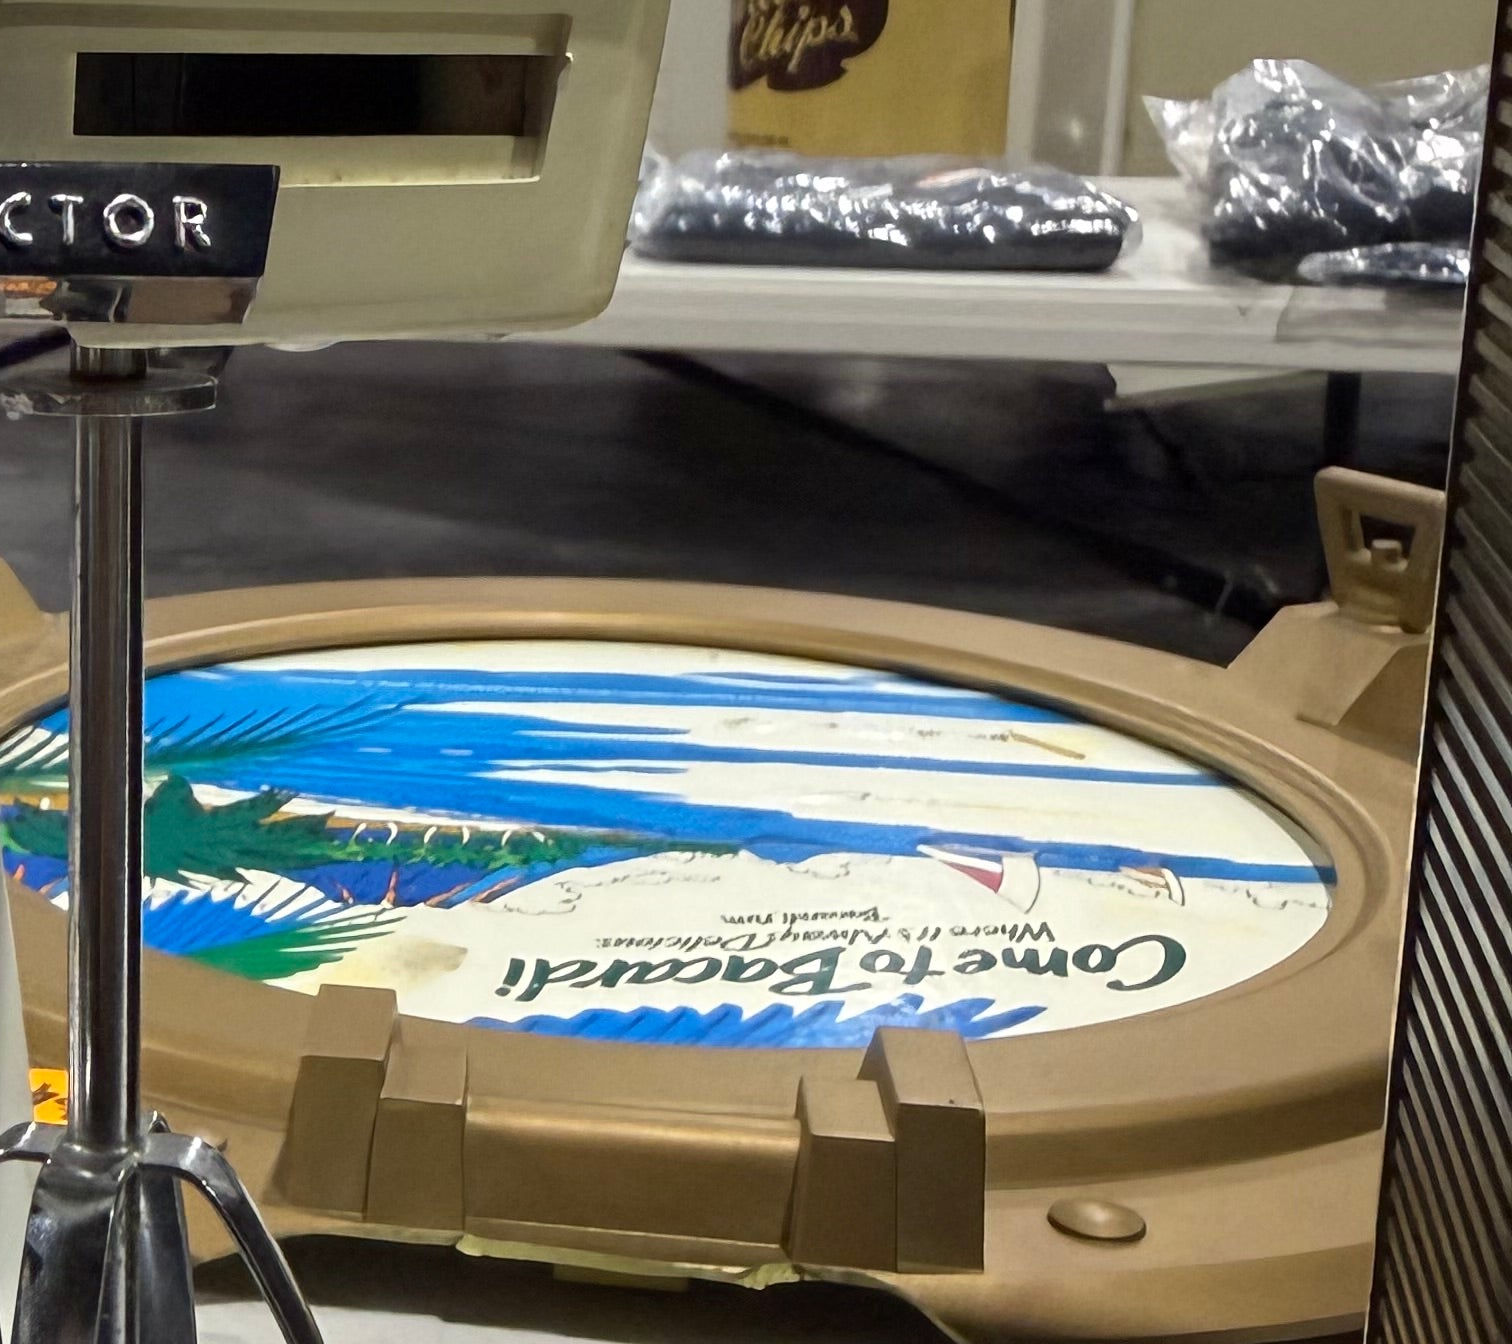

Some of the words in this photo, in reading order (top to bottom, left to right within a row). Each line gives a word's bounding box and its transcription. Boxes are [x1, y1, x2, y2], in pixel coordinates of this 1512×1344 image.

[949, 921, 1055, 944] Where
[494, 946, 872, 1003] Bacardi
[859, 945, 945, 986] to
[953, 933, 1187, 991] Come
